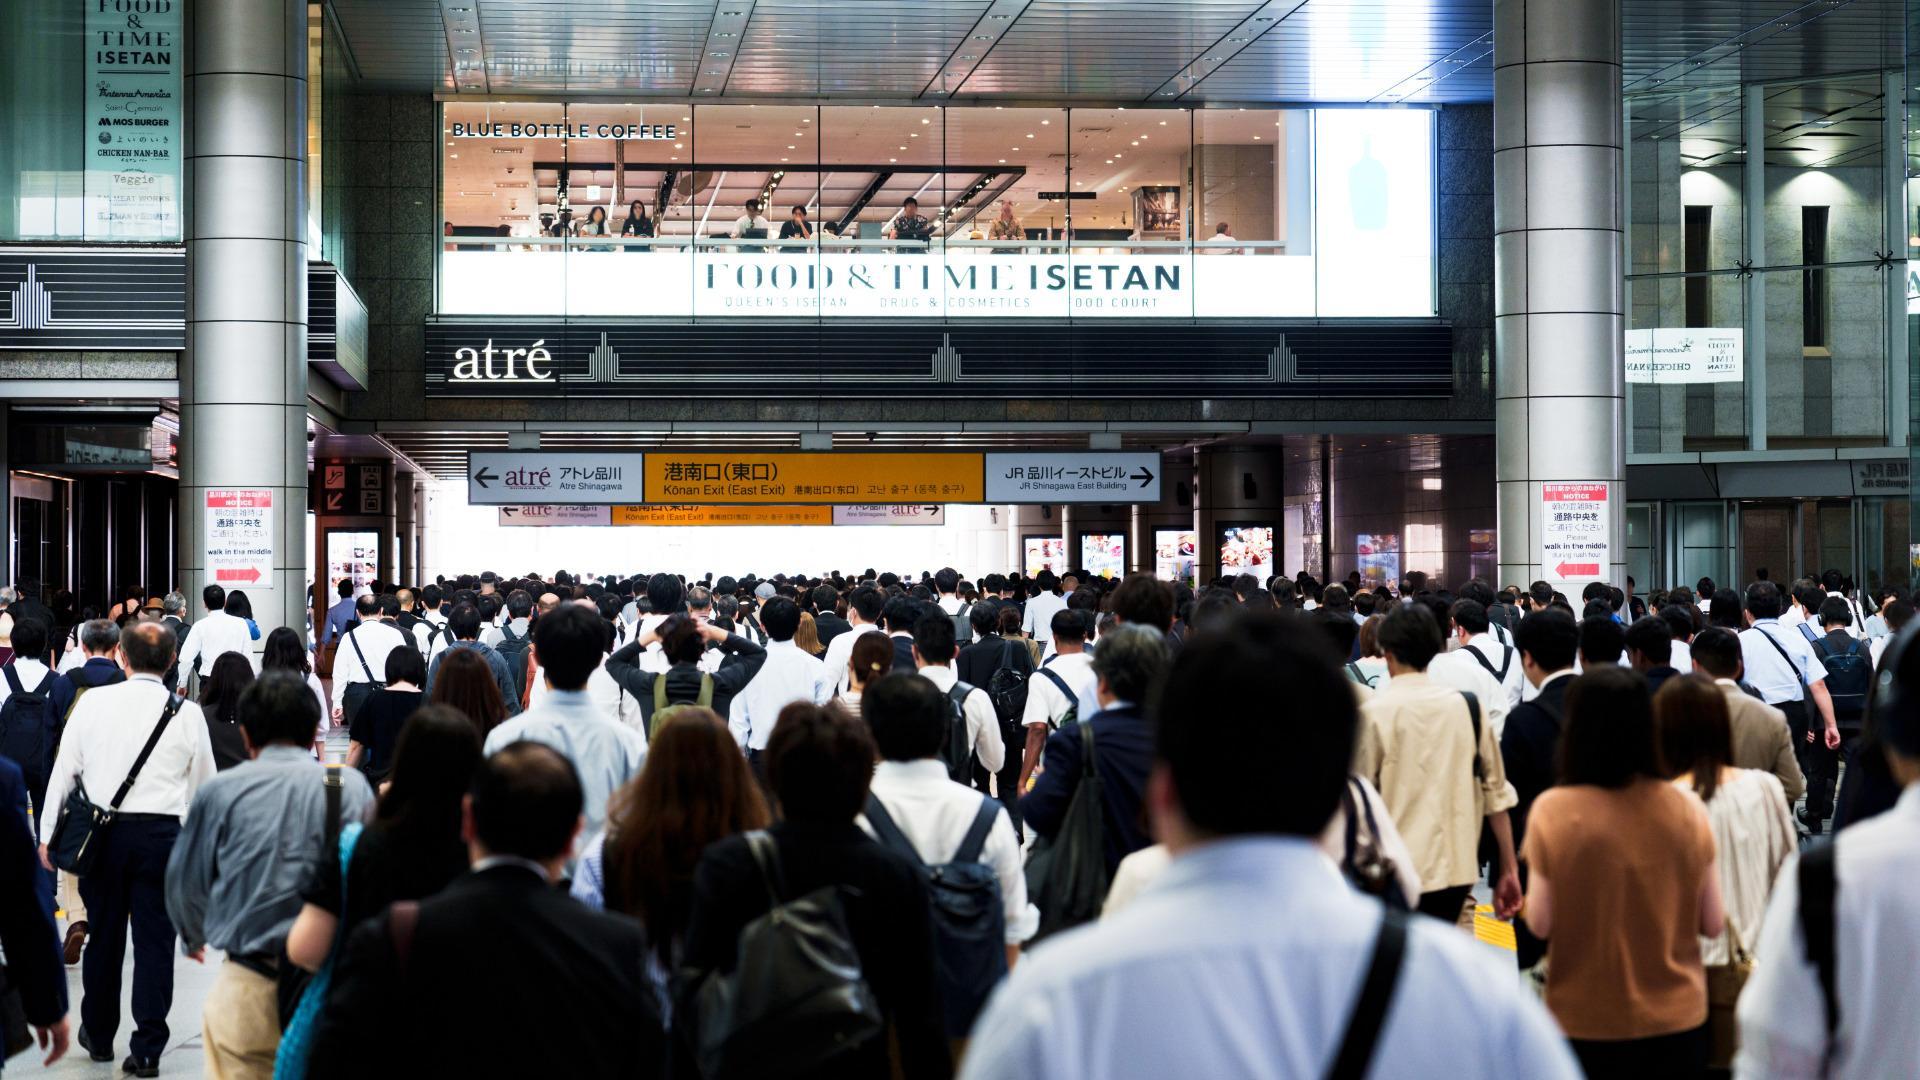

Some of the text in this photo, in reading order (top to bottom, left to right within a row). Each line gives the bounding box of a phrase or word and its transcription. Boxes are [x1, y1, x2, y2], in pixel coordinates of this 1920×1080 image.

[97, 0, 171, 13] FOOD
[127, 13, 144, 29] &
[97, 31, 171, 47] TIME
[97, 51, 171, 65] ISETAN
[453, 123, 676, 138] BLUE BOTTLE COFFEE
[97, 149, 170, 157] CHICKEN NAN-BAR
[113, 174, 154, 185] Veggie
[707, 264, 1180, 290] FOOD & TIME ISETAN
[880, 297, 919, 307] DRUG
[929, 297, 938, 307] &
[948, 297, 1031, 308] COSMETICS
[1074, 297, 1104, 307] OOD
[1111, 297, 1158, 308] COURT
[453, 339, 552, 379] atré
[505, 466, 551, 487] atré
[559, 466, 622, 480] アトレ品川
[1005, 466, 1127, 480] JR 品川イーストビル
[559, 482, 623, 492] Atre Shinagawa
[663, 484, 785, 496] Kōnan Exit (East Exit)
[1019, 482, 1127, 491] JR Shinagawa East Building
[216, 519, 262, 527] 通路中央を
[1553, 513, 1599, 521] 通路中央を
